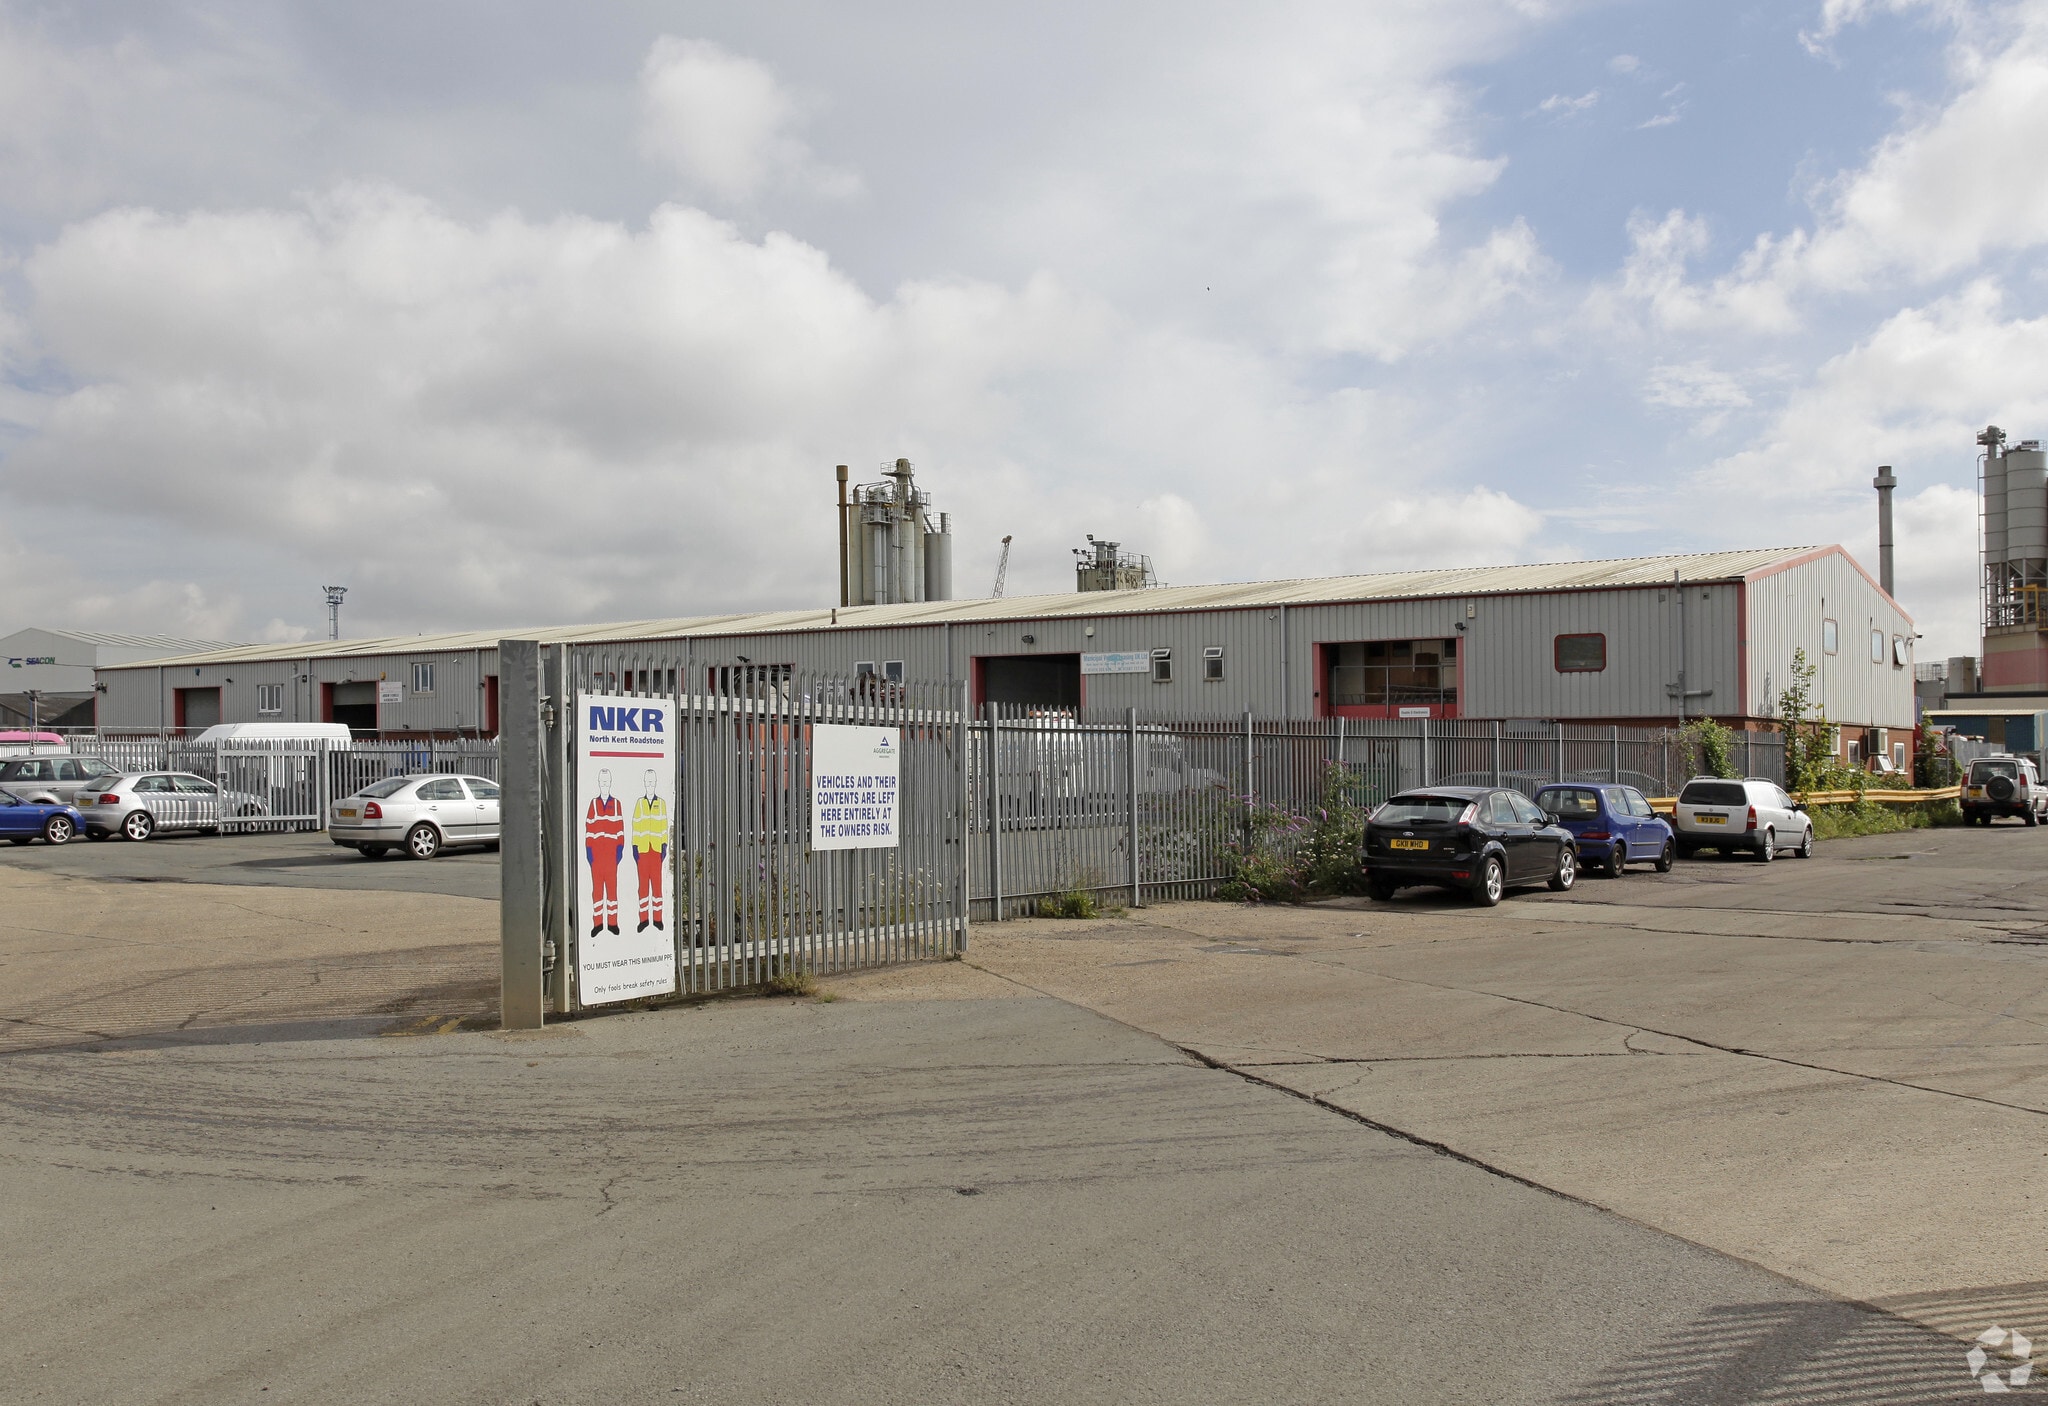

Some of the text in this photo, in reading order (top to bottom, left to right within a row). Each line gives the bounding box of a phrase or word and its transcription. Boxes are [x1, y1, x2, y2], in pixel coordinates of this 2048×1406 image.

[26, 657, 56, 665] SEACON
[590, 706, 664, 732] NKR
[590, 735, 609, 743] North
[816, 776, 896, 788] VEHICLES AND THEIR
[817, 792, 895, 805] CONTENTS ARE LEFT
[821, 807, 892, 821] HERE ENTIRELY AT
[821, 823, 892, 838] THE OWNERS RISK.
[583, 963, 594, 971] YOU
[596, 961, 611, 969] MUST
[629, 957, 641, 966] THIS
[641, 955, 664, 964] MINIMUM
[664, 953, 673, 961] PPE
[594, 986, 606, 994] Only
[608, 983, 621, 991] fools
[622, 981, 638, 989] break
